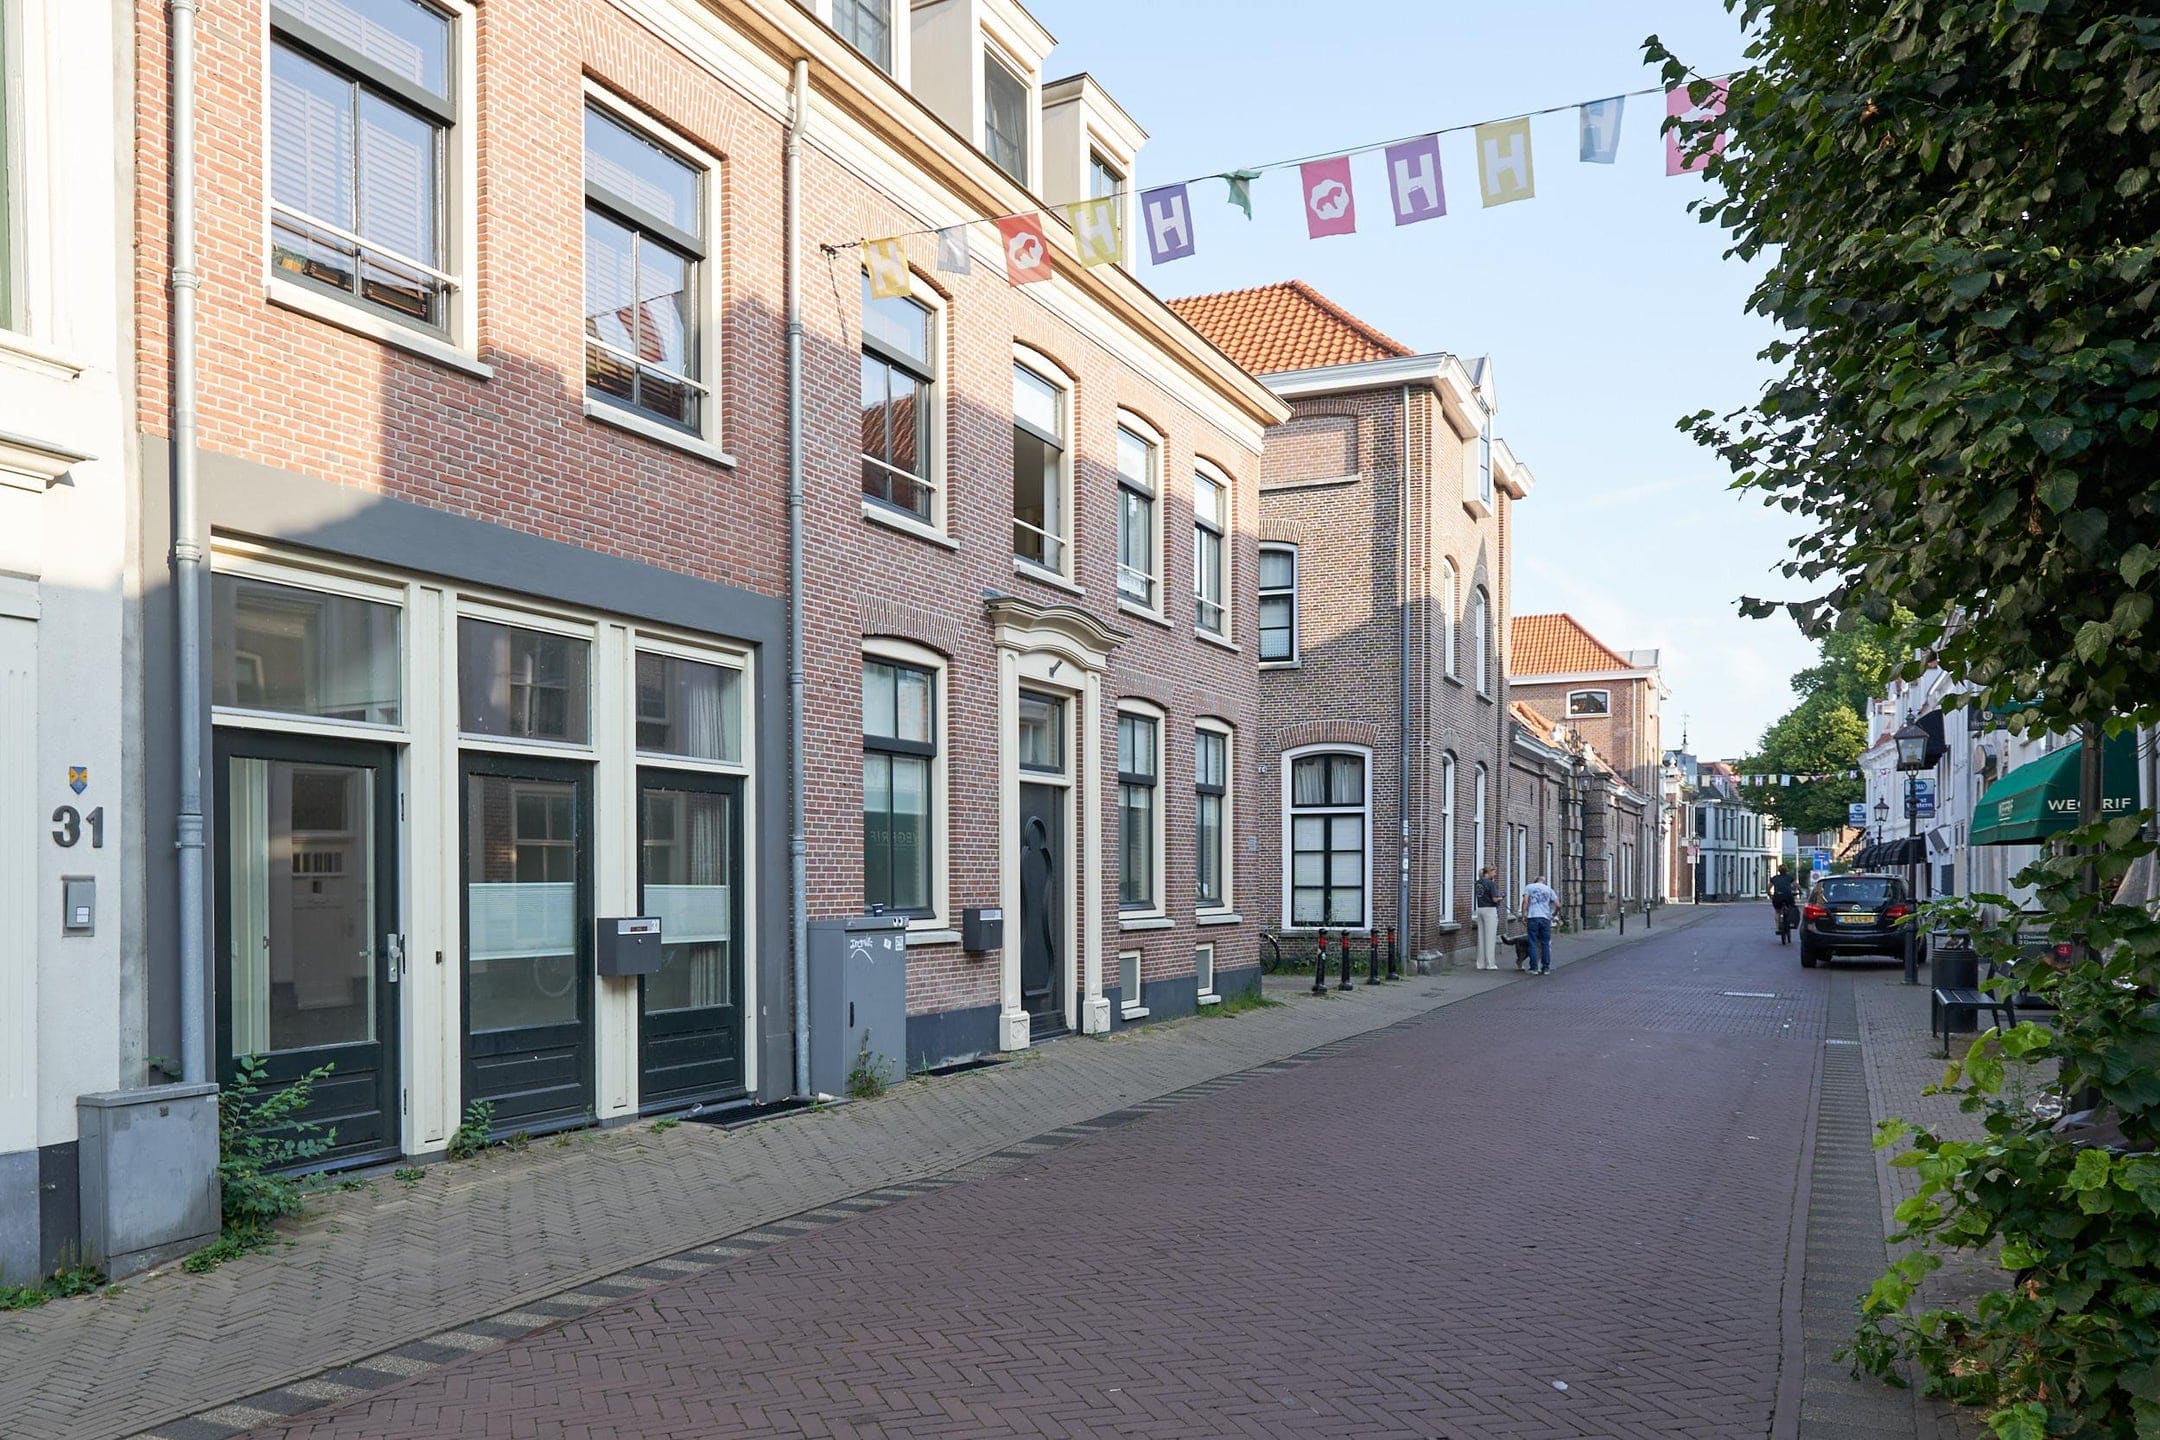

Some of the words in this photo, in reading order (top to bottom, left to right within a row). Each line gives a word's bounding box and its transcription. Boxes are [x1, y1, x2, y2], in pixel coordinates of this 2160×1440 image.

[1395, 153, 1439, 216] H
[1483, 133, 1528, 197] H
[1075, 204, 1117, 259] H
[1149, 195, 1188, 254] H
[869, 241, 905, 291] H
[51, 805, 104, 849] 31
[2048, 797, 2132, 811] WERIF
